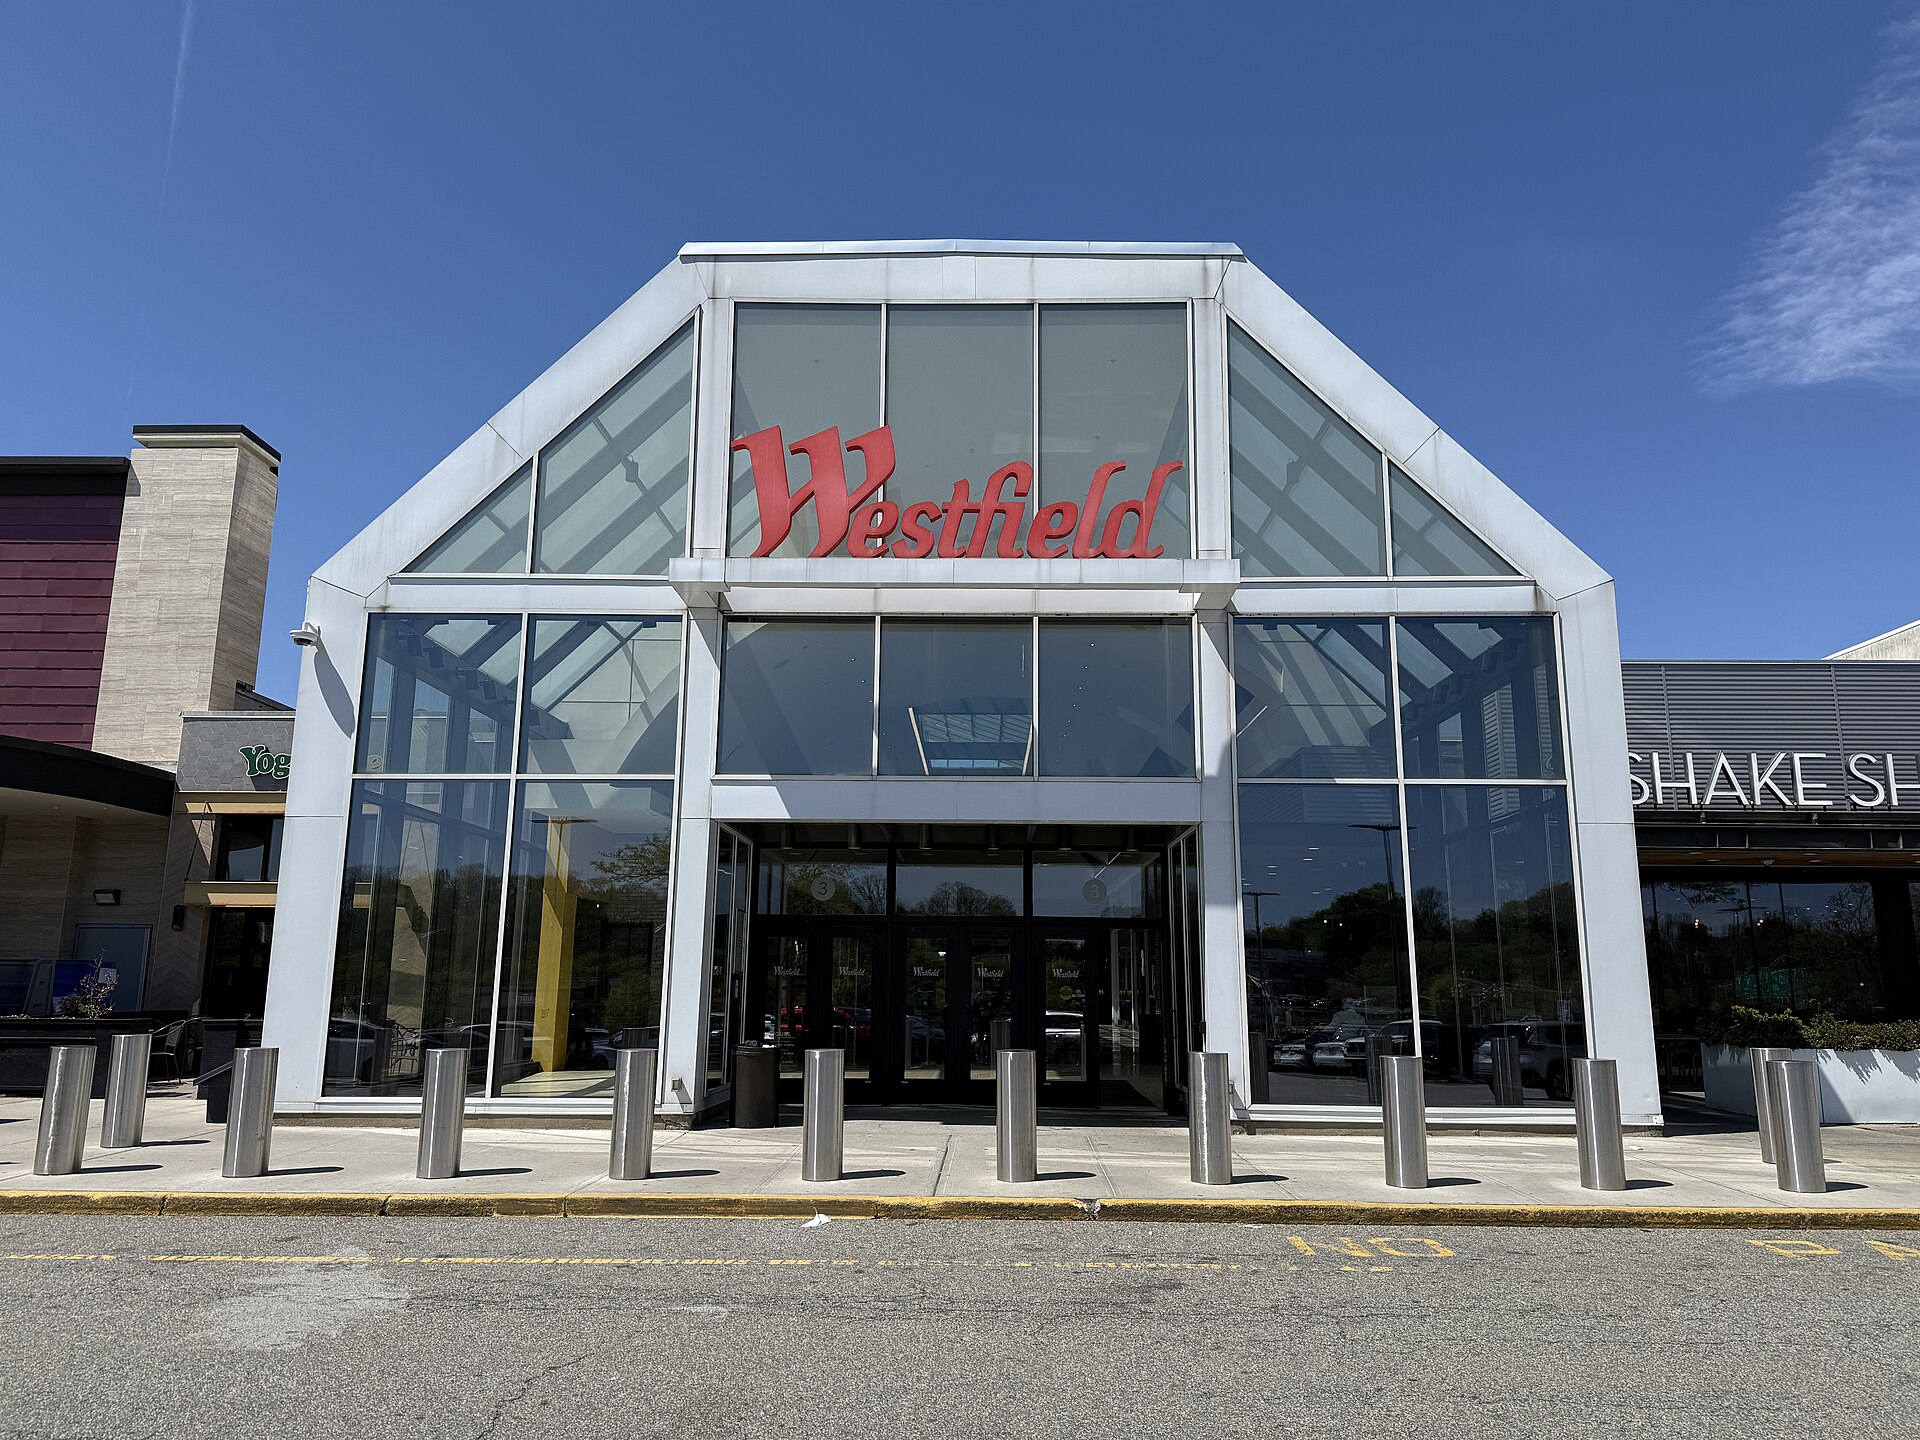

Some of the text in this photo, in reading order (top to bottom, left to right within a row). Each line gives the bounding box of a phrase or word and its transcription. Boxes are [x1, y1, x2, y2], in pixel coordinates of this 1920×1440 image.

[731, 425, 1183, 559] Westfield
[239, 745, 292, 780] Yog
[1628, 750, 1834, 807] SHAKE
[818, 881, 828, 896] 3
[1091, 885, 1099, 898] 3
[773, 965, 801, 976] Westfield
[838, 966, 866, 976] Westfield
[912, 966, 941, 977] Westfield
[977, 967, 1004, 978] Westfield
[1052, 968, 1080, 979] Westfield
[1285, 1236, 1456, 1258] NO
